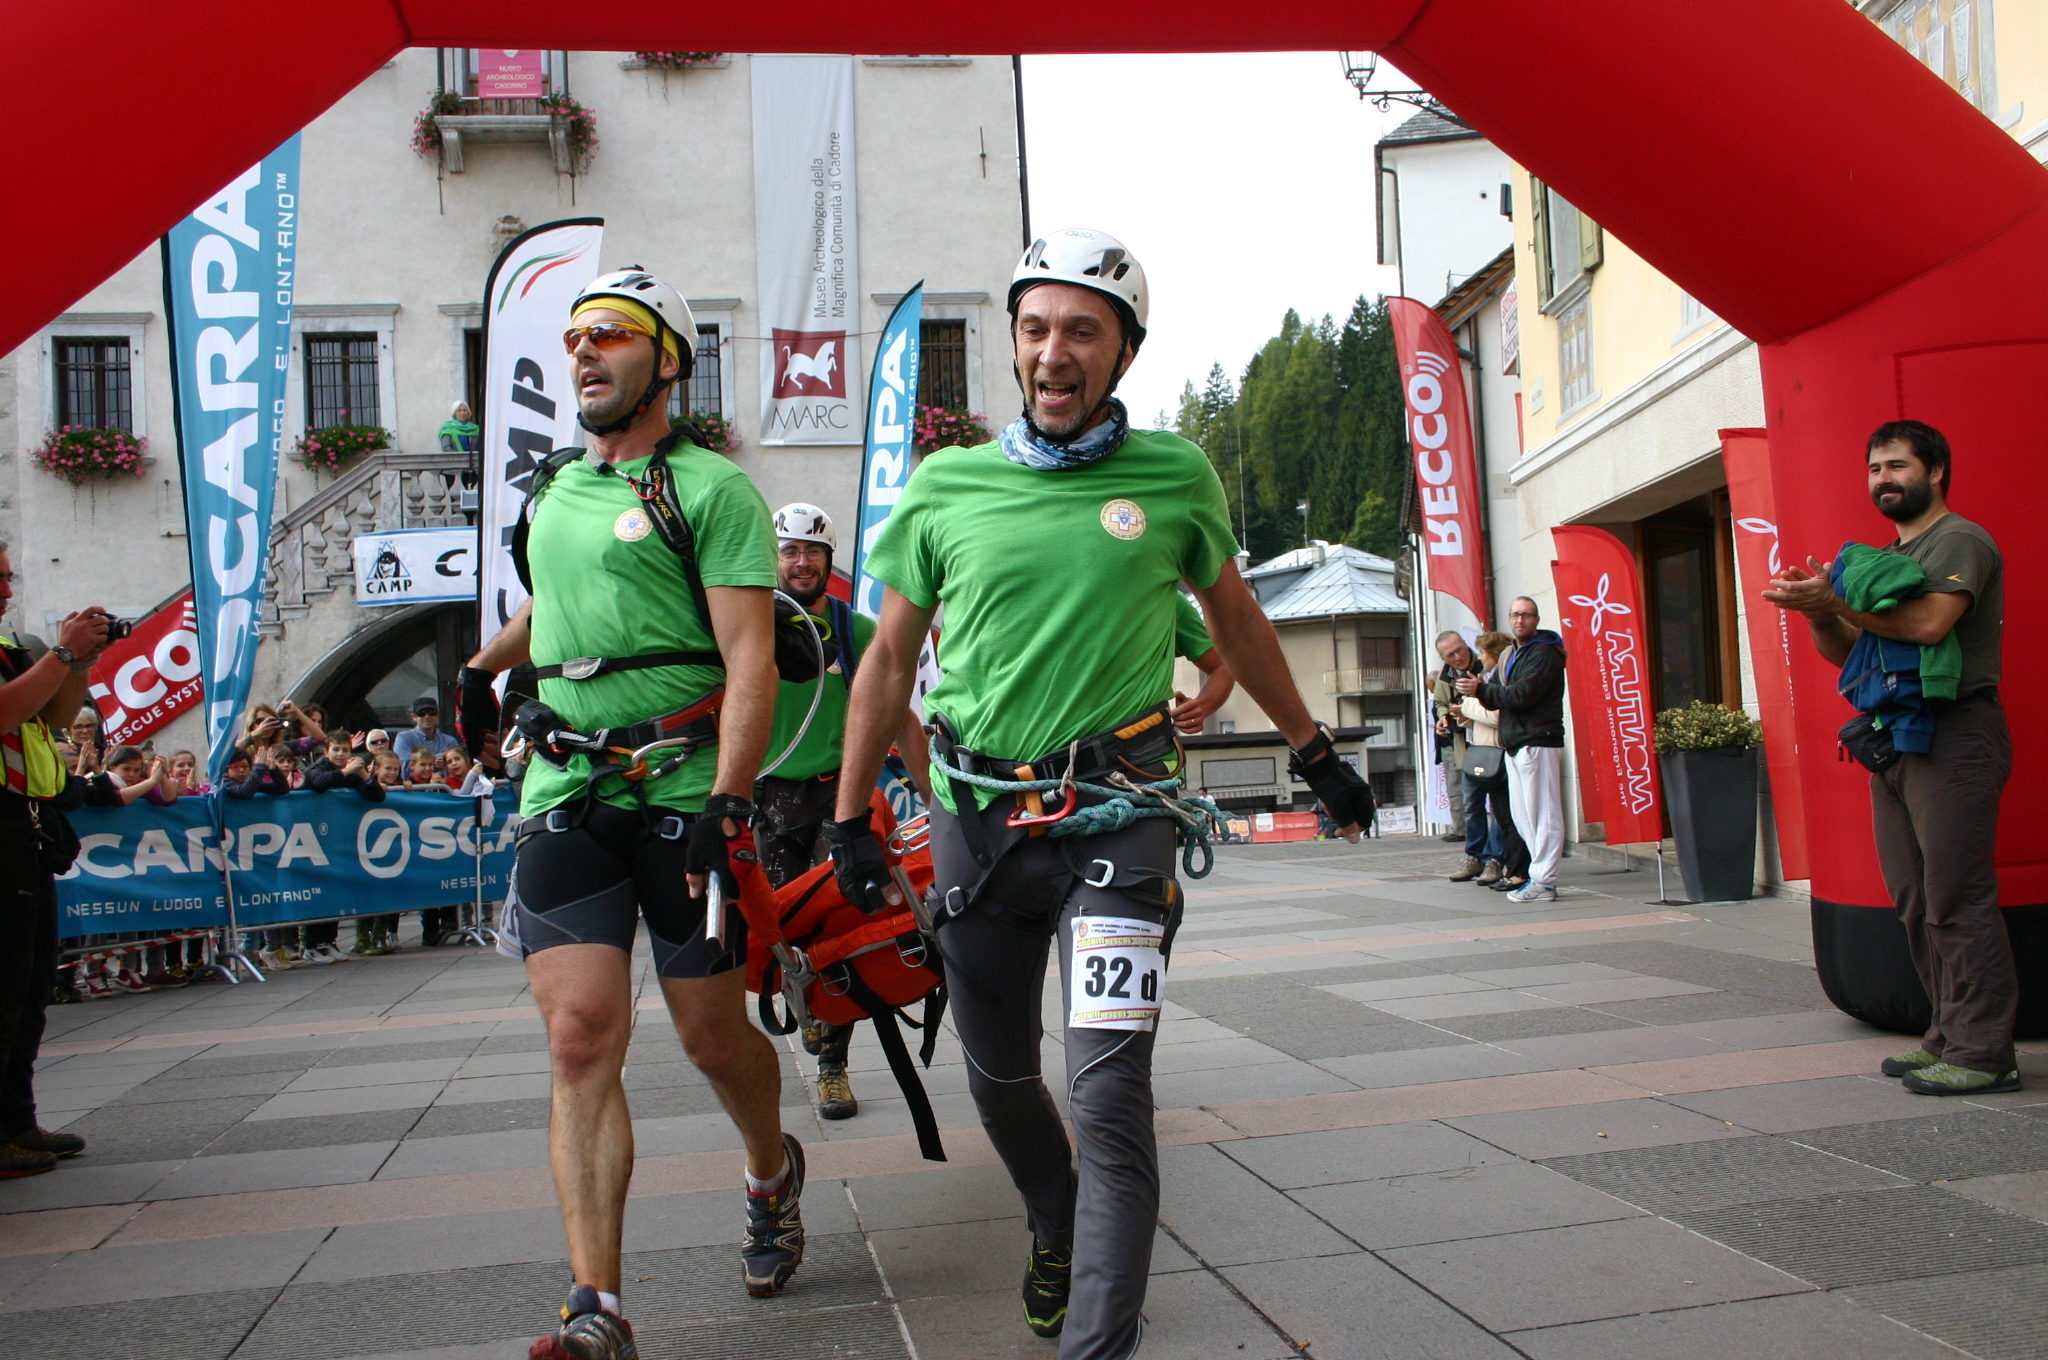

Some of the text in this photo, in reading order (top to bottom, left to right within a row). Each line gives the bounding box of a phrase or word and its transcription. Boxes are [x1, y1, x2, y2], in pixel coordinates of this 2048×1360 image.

[811, 157, 827, 318] Museo Archeologico della
[828, 132, 847, 318] Magnifica Comunità di Cadore
[771, 404, 849, 430] MARC
[366, 580, 413, 594] CAMP
[165, 676, 204, 709] SYST
[67, 900, 140, 918] NESSUN
[153, 897, 203, 912] LUOGO
[215, 896, 225, 909] E
[1085, 955, 1158, 1003] 32 d
